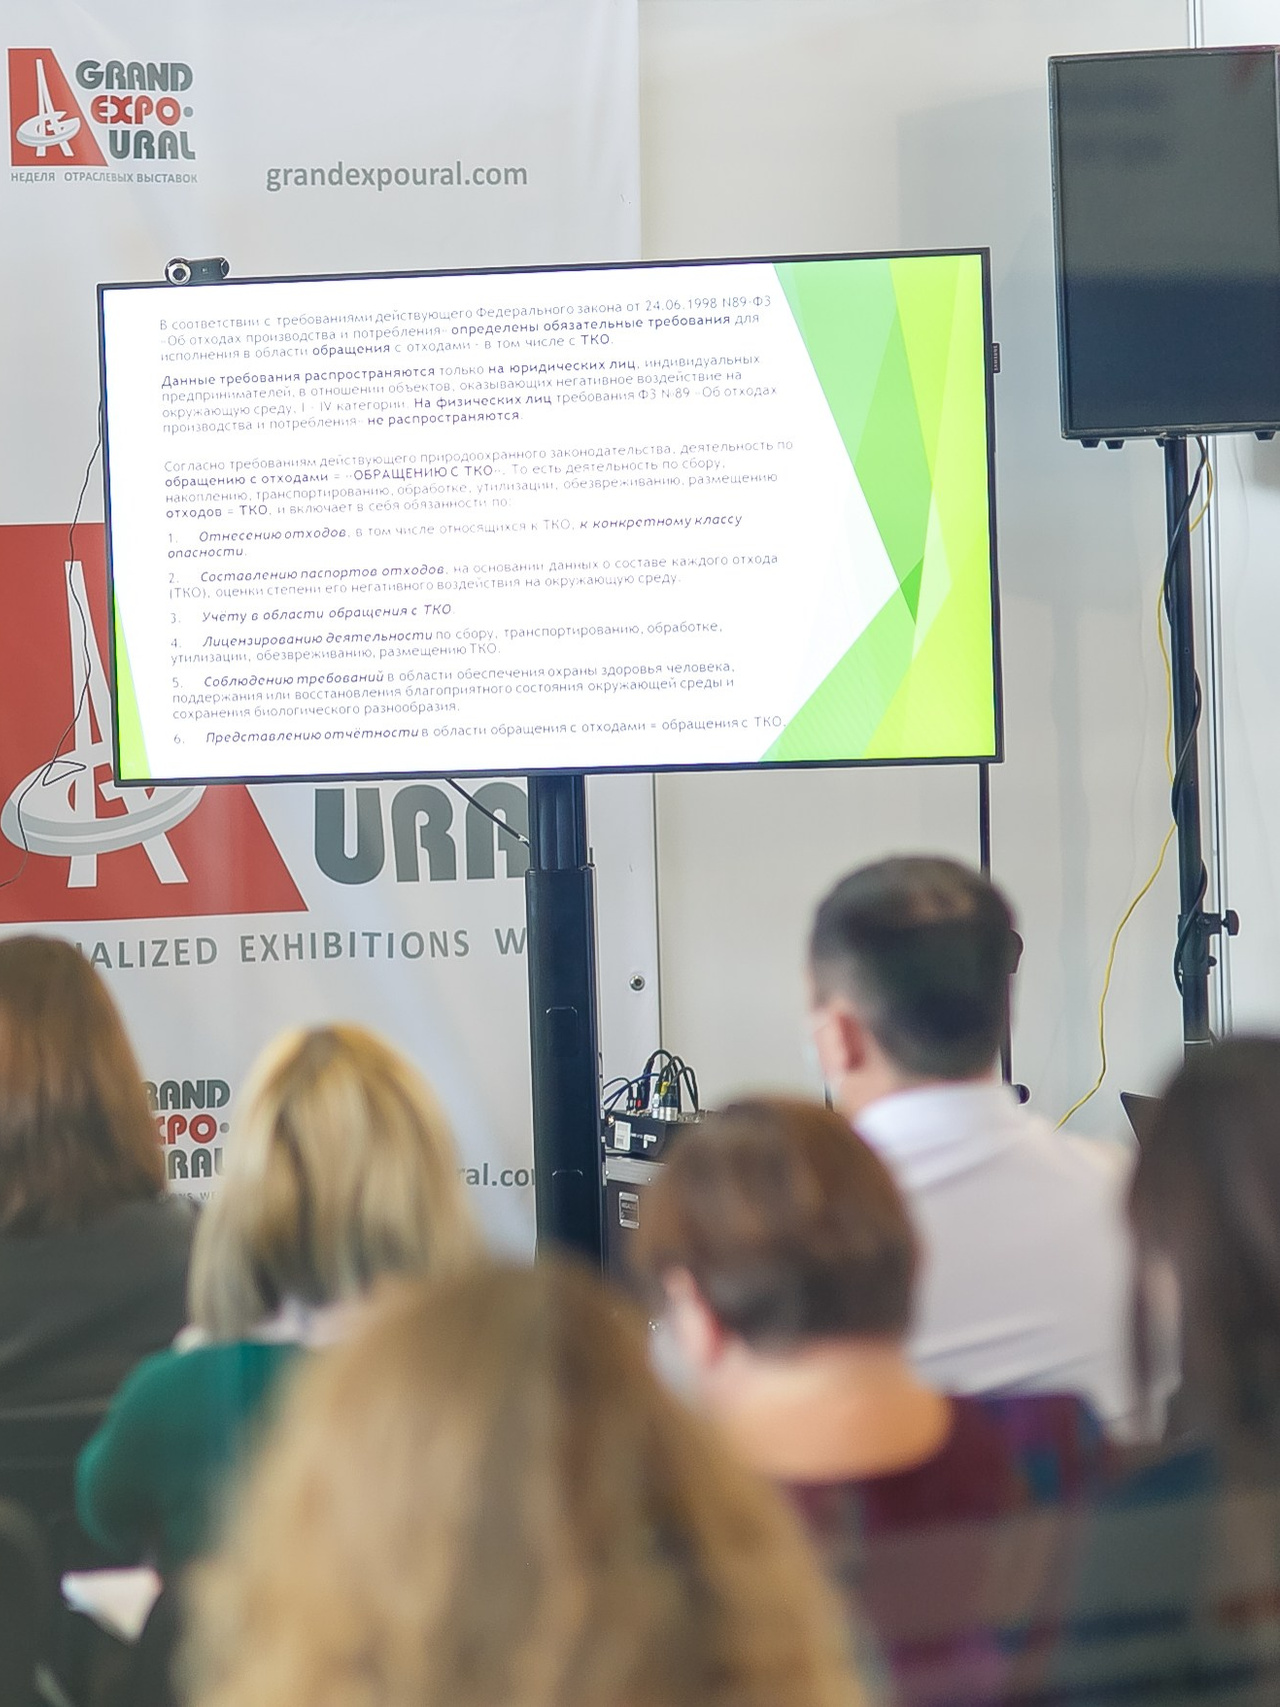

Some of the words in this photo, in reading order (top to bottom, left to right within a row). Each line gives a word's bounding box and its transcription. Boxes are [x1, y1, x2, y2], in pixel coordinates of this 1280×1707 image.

[76, 60, 193, 92] GRAND
[109, 130, 195, 159] URAL
[11, 172, 55, 183] НЕДЕЛЯ
[64, 172, 133, 182] ОТРАСЛЕВЫХ
[137, 173, 197, 183] ВЫСТАВОК
[267, 161, 527, 191] grandexpoural.com
[171, 318, 260, 331] соответствии
[276, 313, 373, 329] требованиями
[374, 309, 473, 325] действующего
[475, 305, 575, 320] Федерального
[577, 303, 623, 314] закона
[626, 302, 640, 312] от
[645, 297, 718, 312] 24.06.1998
[189, 335, 242, 347] отходах
[245, 330, 336, 346] производства
[451, 322, 539, 338] определены
[543, 318, 644, 332] обязательные
[647, 314, 731, 331] требования
[160, 350, 240, 362] исполнения
[255, 346, 308, 359] области
[312, 343, 390, 359] обращения
[406, 341, 471, 354] отходами
[525, 337, 565, 348] числе
[160, 375, 216, 390] Данные
[219, 371, 301, 388] требования
[304, 367, 435, 385] распространяются
[439, 365, 485, 376] только
[488, 365, 505, 374] на
[509, 360, 606, 377] юридических
[644, 355, 760, 370] индивидуальных
[310, 385, 384, 397] отношении
[459, 379, 553, 391] оказывающих
[556, 375, 634, 387] негативное
[637, 370, 722, 386] воздействие
[726, 371, 742, 381] на
[161, 406, 251, 421] окружающую
[320, 401, 332, 412] IV
[413, 397, 431, 409] На
[435, 395, 522, 411] физических
[525, 395, 553, 406] лиц
[556, 390, 635, 406] требования
[723, 386, 777, 398] отходах
[163, 421, 253, 436] производства
[367, 416, 384, 426] не
[163, 460, 226, 473] Согласно
[229, 457, 317, 473] требованиям
[319, 454, 417, 469] действующего
[420, 450, 547, 465] природоохранного
[679, 441, 774, 456] деятельность
[164, 475, 246, 490] обращению
[261, 473, 329, 485] отходами
[532, 464, 562, 475] есть
[565, 461, 658, 475] деятельность
[688, 473, 778, 488] размещению
[165, 508, 222, 520] отходов
[289, 503, 353, 515] включает
[368, 499, 400, 512] себя
[403, 498, 487, 511] обязанности
[198, 530, 282, 543] Отнесению
[395, 525, 435, 536] числе
[439, 522, 526, 535] относящихся
[592, 517, 692, 531] конкретному
[694, 515, 743, 528] классу
[200, 570, 298, 583] Составлению
[300, 567, 378, 581] паспортов
[472, 562, 544, 574] основании
[548, 561, 599, 573] данных
[614, 557, 667, 569] составе
[671, 556, 729, 568] каждого
[732, 554, 778, 566] отхода
[215, 587, 264, 599] оценки
[266, 585, 321, 596] степени
[351, 581, 434, 593] негативного
[436, 576, 521, 592] воздействия
[525, 578, 541, 588] на
[544, 574, 635, 589] окружающую
[201, 609, 248, 625] Учёту
[262, 608, 324, 621] области
[328, 606, 408, 622] обращения
[202, 634, 323, 649] Лицензированию
[325, 631, 433, 644] деятельности
[379, 645, 467, 661] размещению
[203, 674, 294, 688] Соблюдению
[296, 669, 385, 688] требований
[399, 669, 453, 682] области
[456, 667, 546, 680] обеспечения
[547, 667, 598, 680] охраны
[601, 664, 663, 678] здоровья
[172, 692, 263, 706] поддержания
[294, 688, 402, 701] восстановления
[405, 684, 513, 699] благоприятного
[515, 682, 584, 694] состояния
[587, 676, 677, 694] окружающей
[679, 678, 723, 692] среды
[172, 708, 251, 722] сохранения
[254, 705, 360, 718] биологического
[205, 730, 322, 747] Представлению
[324, 727, 419, 741] отчётности
[433, 724, 487, 737] области
[490, 723, 567, 738] обращения
[581, 722, 646, 735] отходами
[661, 718, 739, 733] обращения
[315, 782, 528, 885] URA
[76, 937, 218, 969] ALIZED
[241, 930, 469, 962] EXHIBITIONS
[144, 1079, 230, 1110] RAND
